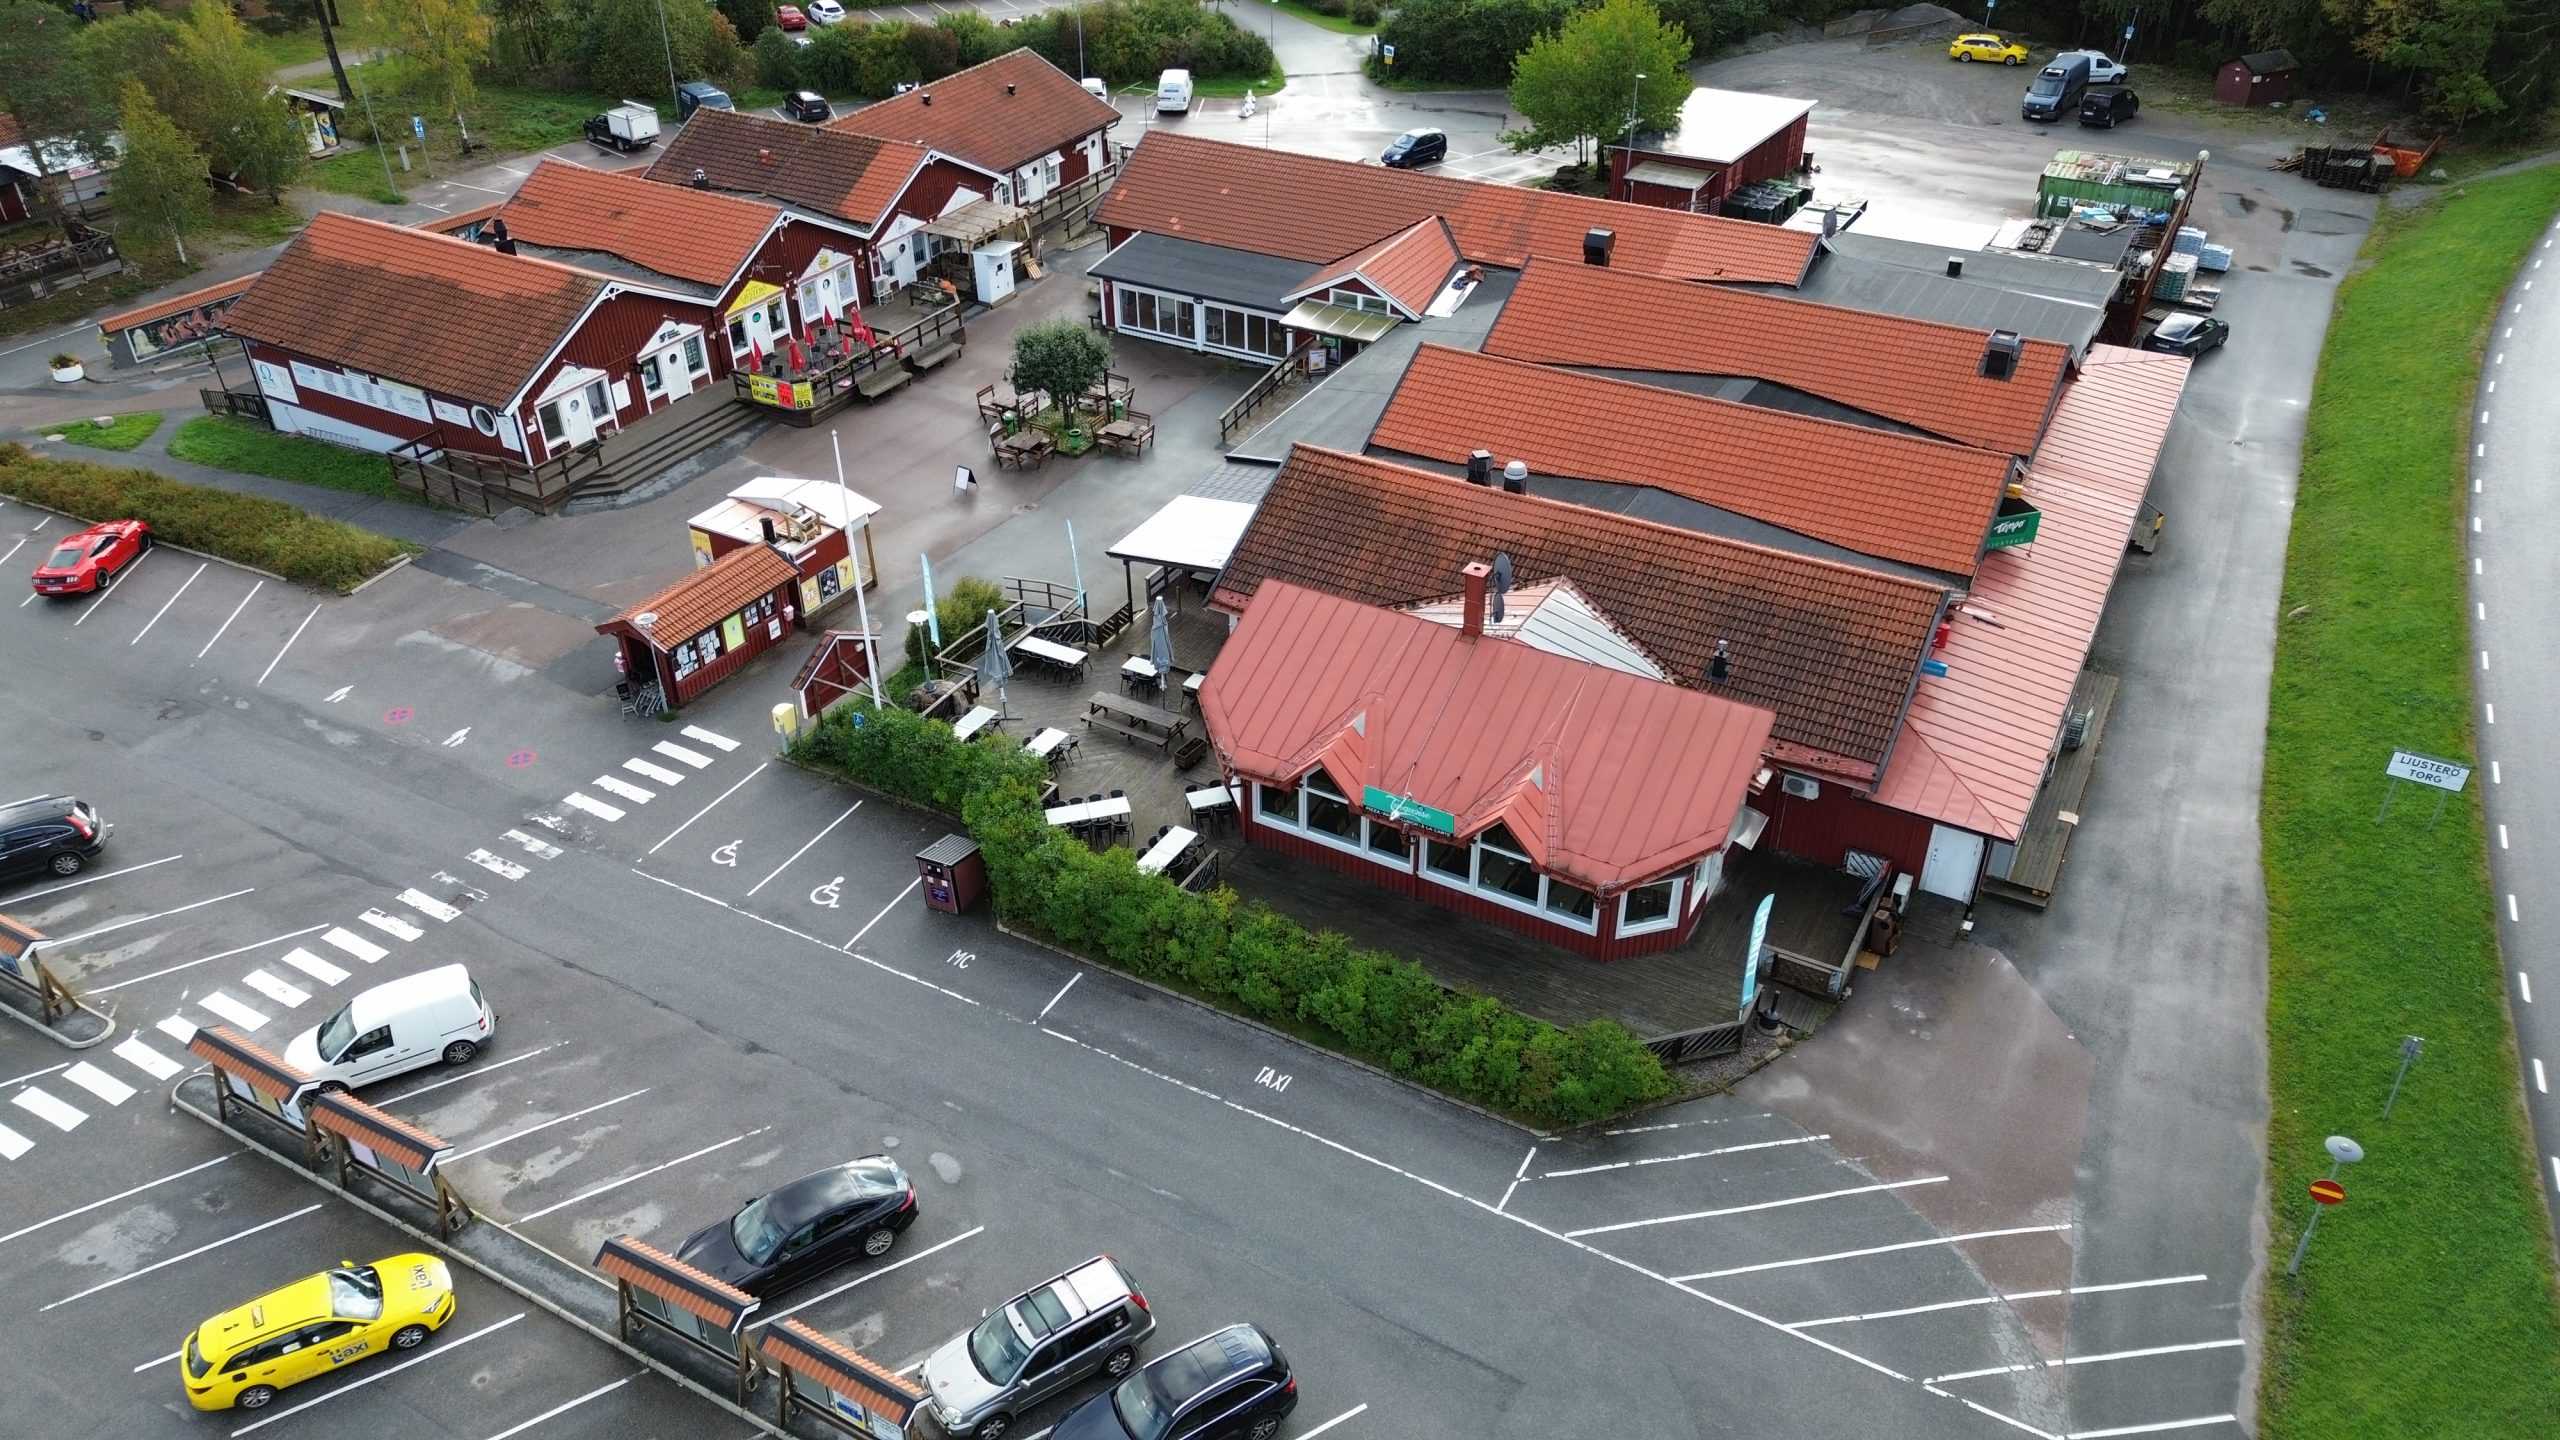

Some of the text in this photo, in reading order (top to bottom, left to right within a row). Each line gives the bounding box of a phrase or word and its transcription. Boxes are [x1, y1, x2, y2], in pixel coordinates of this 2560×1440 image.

[2400, 756, 2460, 777] LJUSTERÖ
[2409, 769, 2442, 783] TORG
[946, 949, 976, 969] MC
[1254, 1066, 1293, 1092] TAXI
